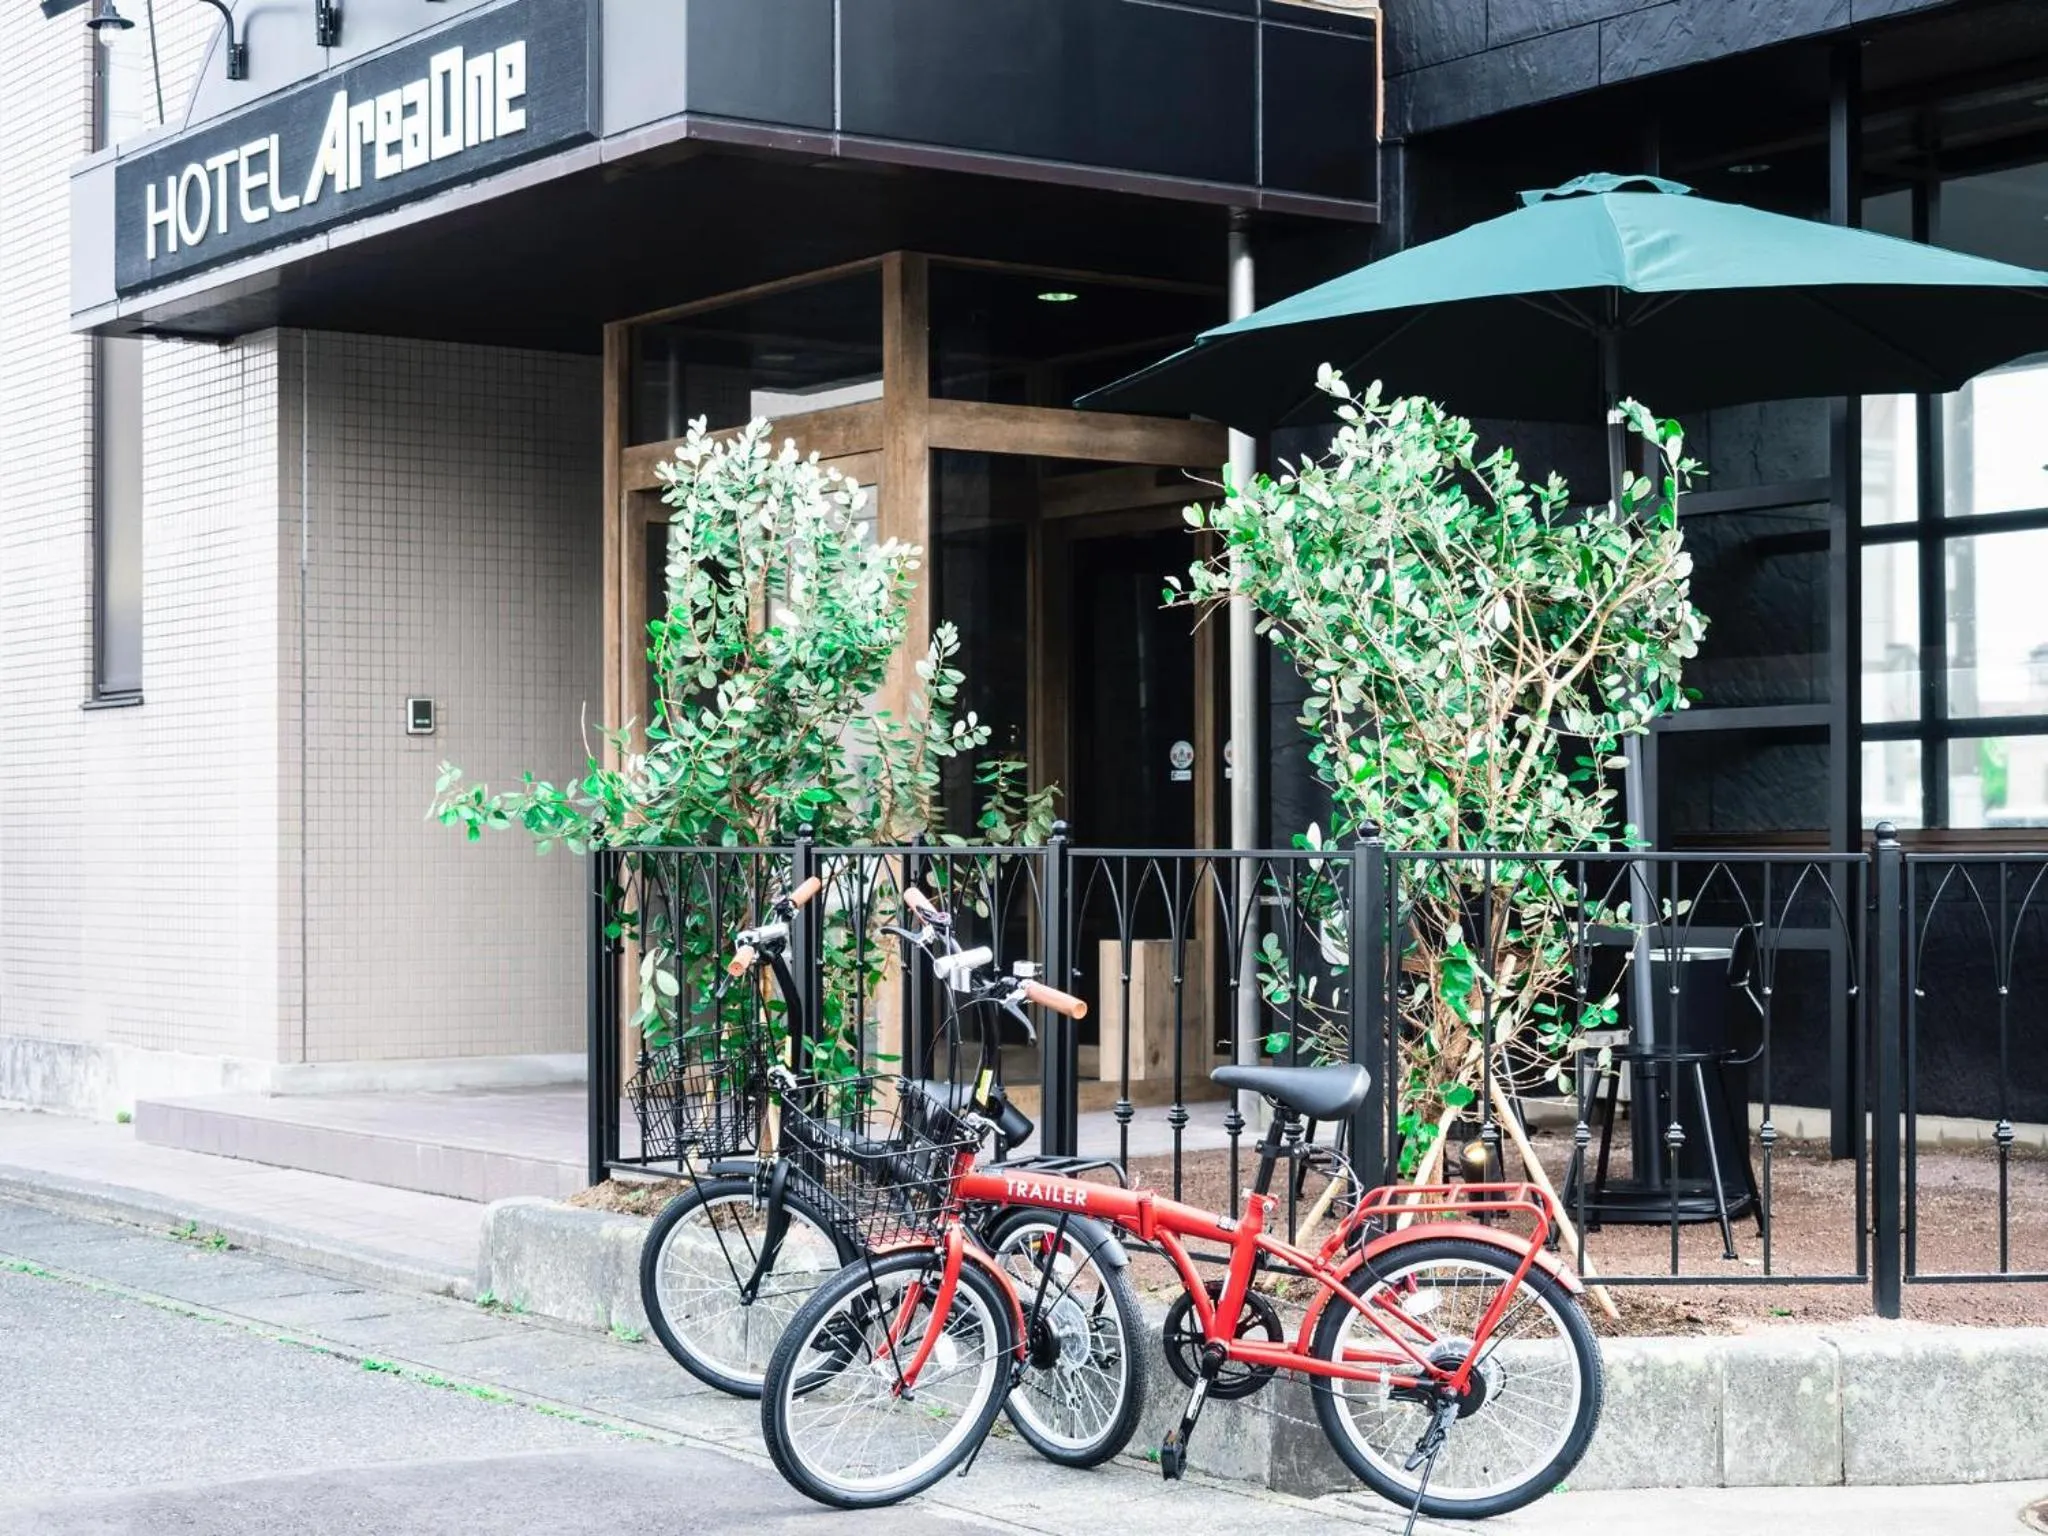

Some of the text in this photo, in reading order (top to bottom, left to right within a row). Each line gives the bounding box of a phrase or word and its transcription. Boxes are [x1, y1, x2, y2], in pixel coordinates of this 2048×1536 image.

[146, 40, 526, 260] HOTEL AreaOne
[1006, 1179, 1088, 1207] TRAILER
